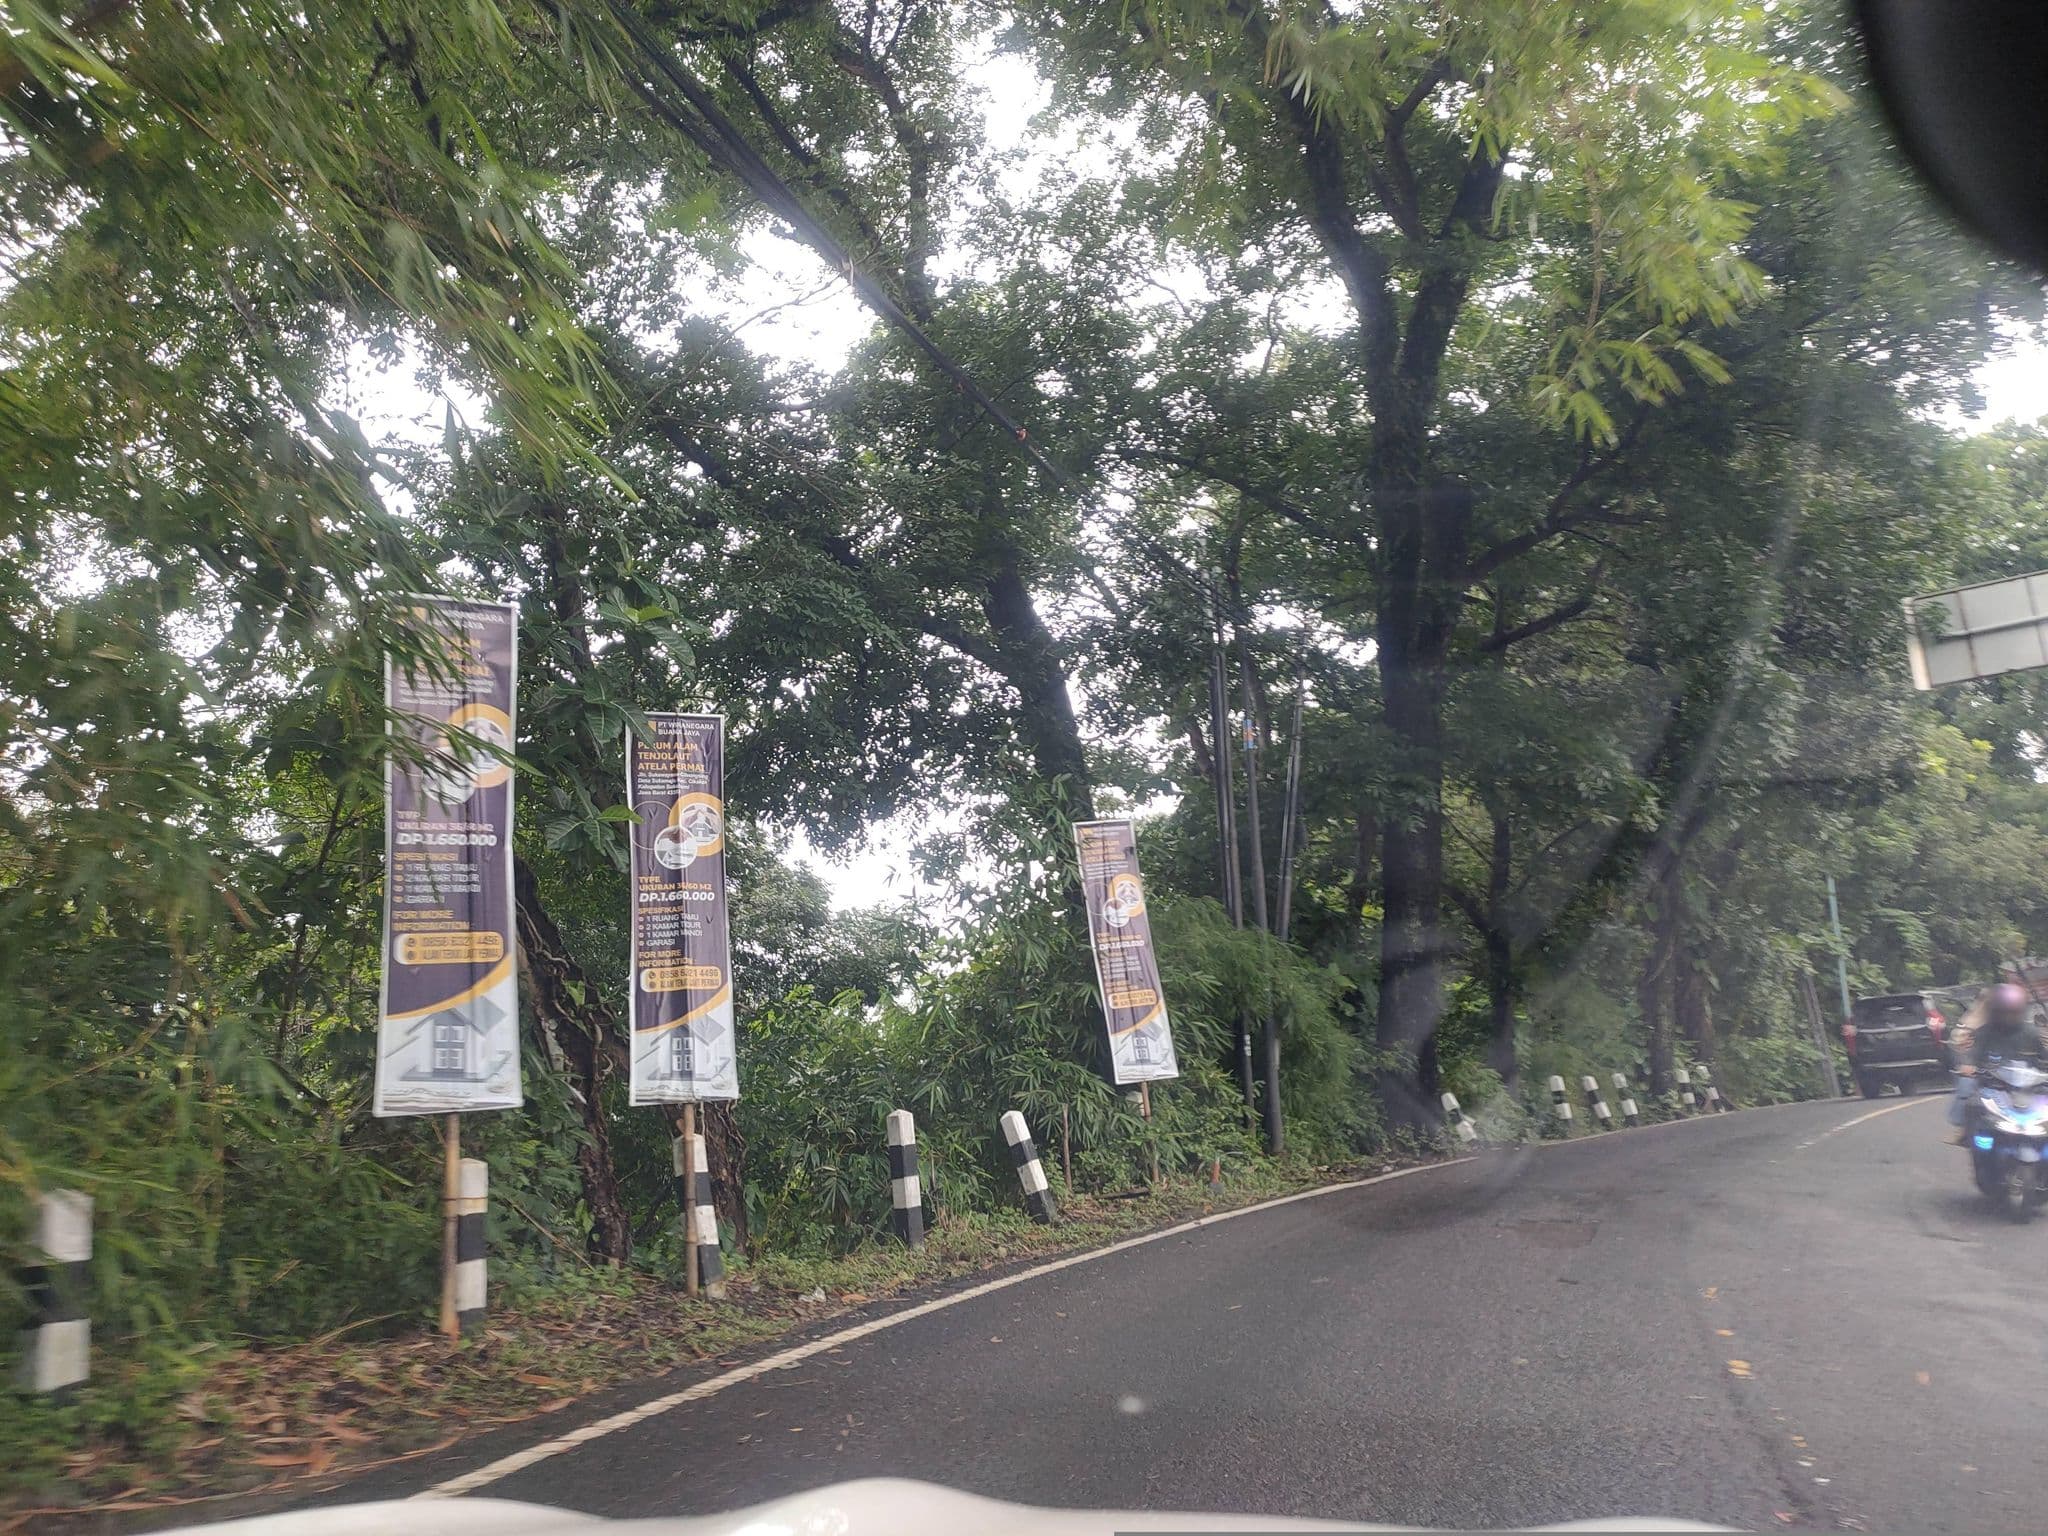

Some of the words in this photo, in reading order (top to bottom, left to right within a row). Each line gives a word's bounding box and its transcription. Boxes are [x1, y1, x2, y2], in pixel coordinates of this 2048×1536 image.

[638, 741, 671, 750] PEUM
[673, 742, 698, 751] ALAM
[638, 751, 692, 761] TENJOLAUT
[638, 762, 667, 771] ATELA
[670, 762, 704, 772] PERMAI
[639, 876, 661, 884] TYPE
[639, 883, 676, 892] UKURAN
[639, 891, 715, 902] DP.1.660.000
[652, 914, 680, 922] RUANG
[652, 922, 680, 930] KAMAR
[652, 930, 680, 938] KAMAR
[646, 938, 675, 947] GARASI
[639, 951, 657, 959] FOR
[657, 949, 681, 958] MORE
